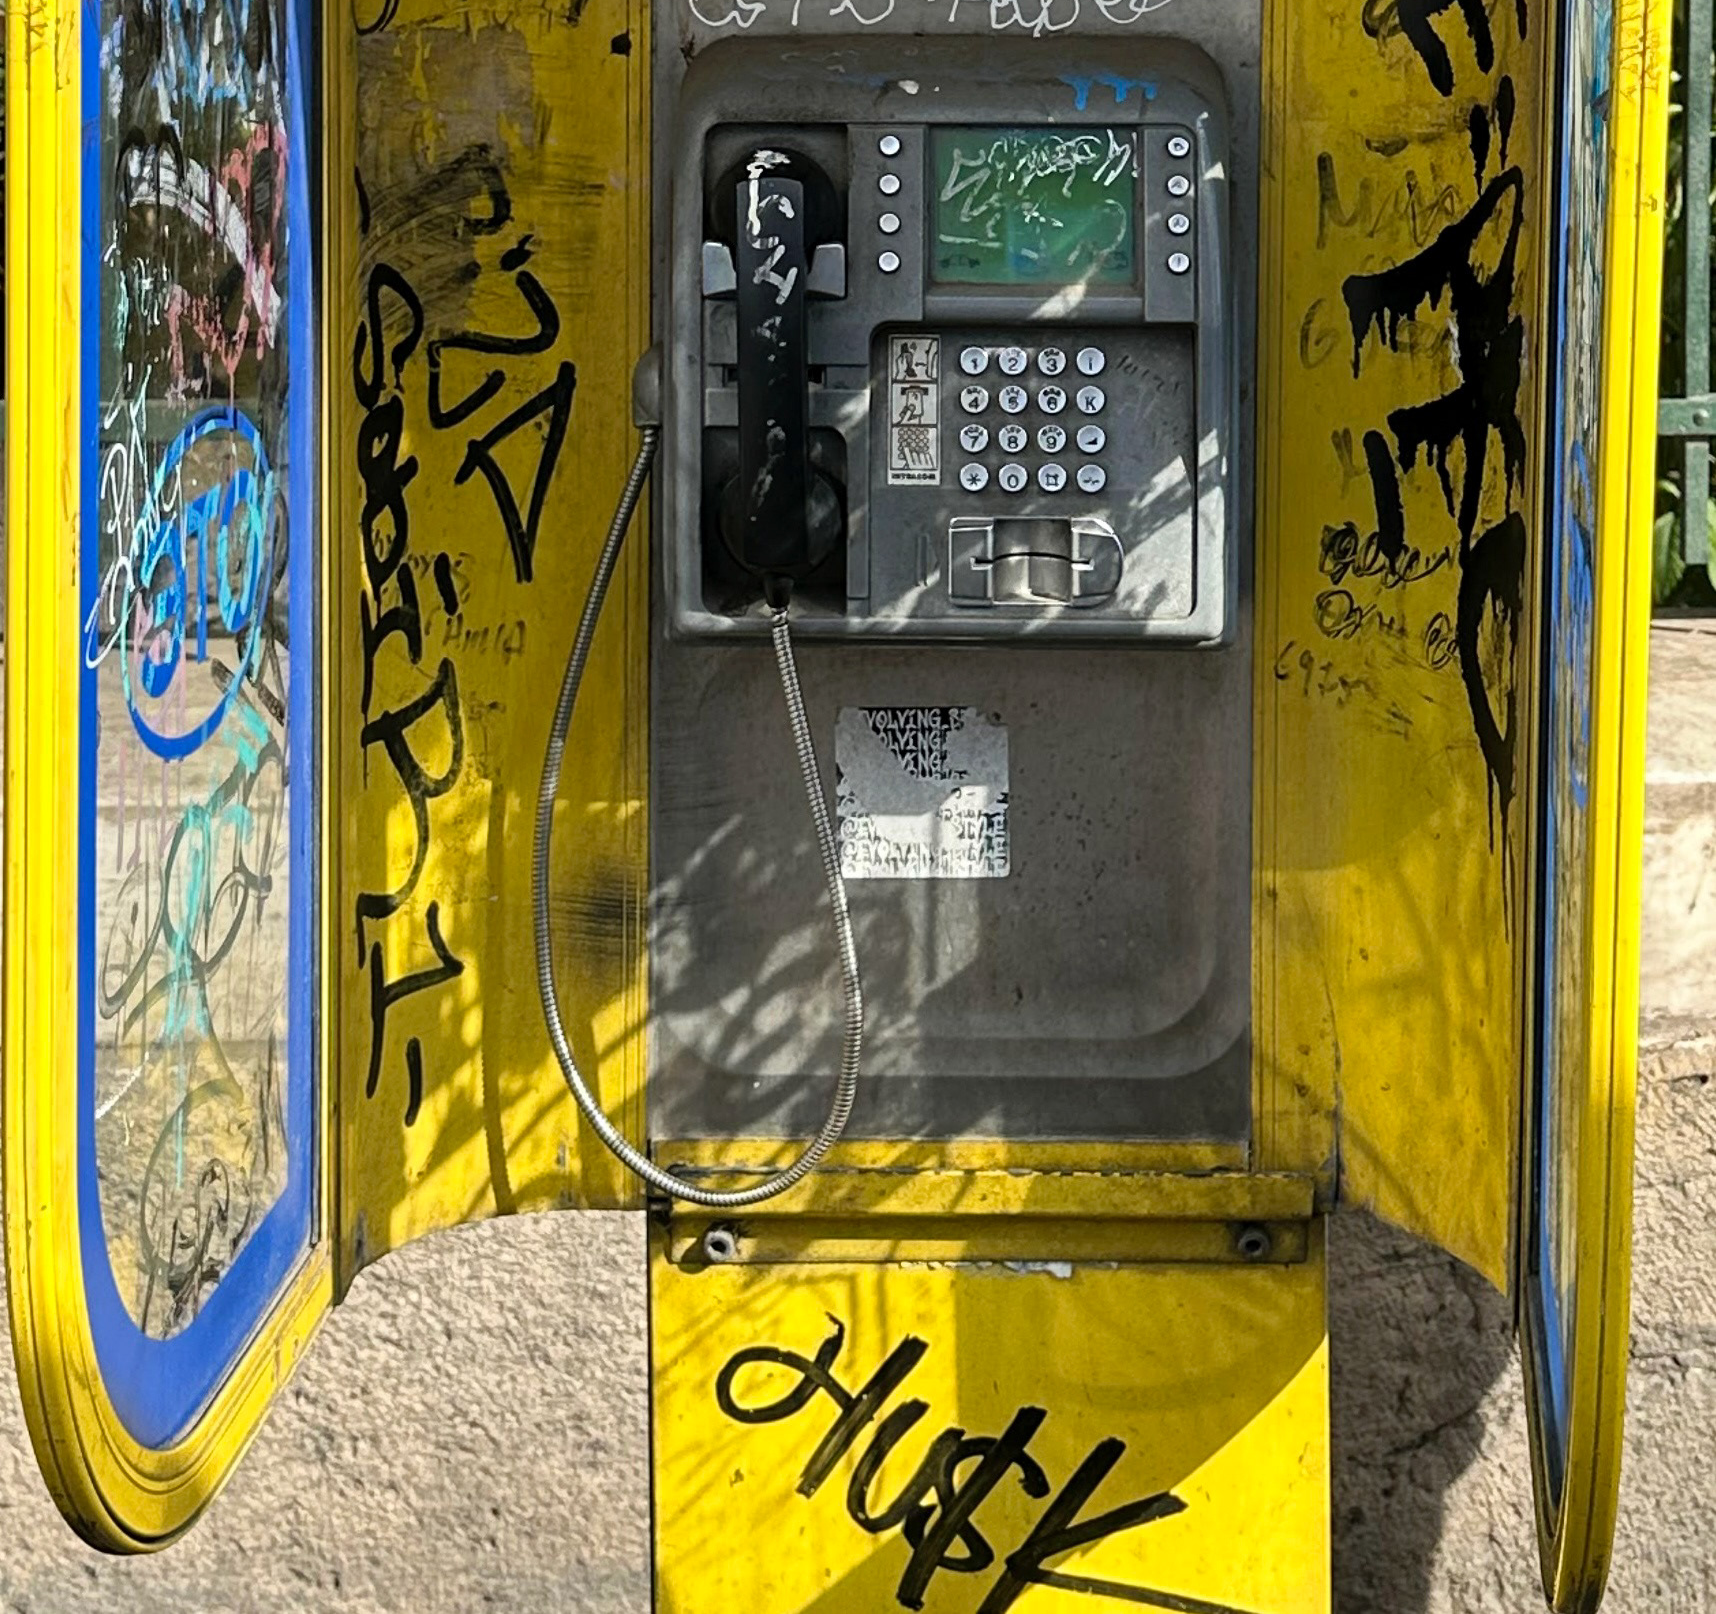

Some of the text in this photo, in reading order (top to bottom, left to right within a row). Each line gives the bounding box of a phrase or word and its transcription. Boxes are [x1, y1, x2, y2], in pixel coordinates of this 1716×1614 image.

[1008, 358, 1019, 372] 2
[1046, 358, 1058, 372] 3
[968, 396, 980, 410] 4
[1085, 396, 1097, 411] K
[969, 436, 1058, 450] 7 8 9
[1006, 474, 1019, 489] 0
